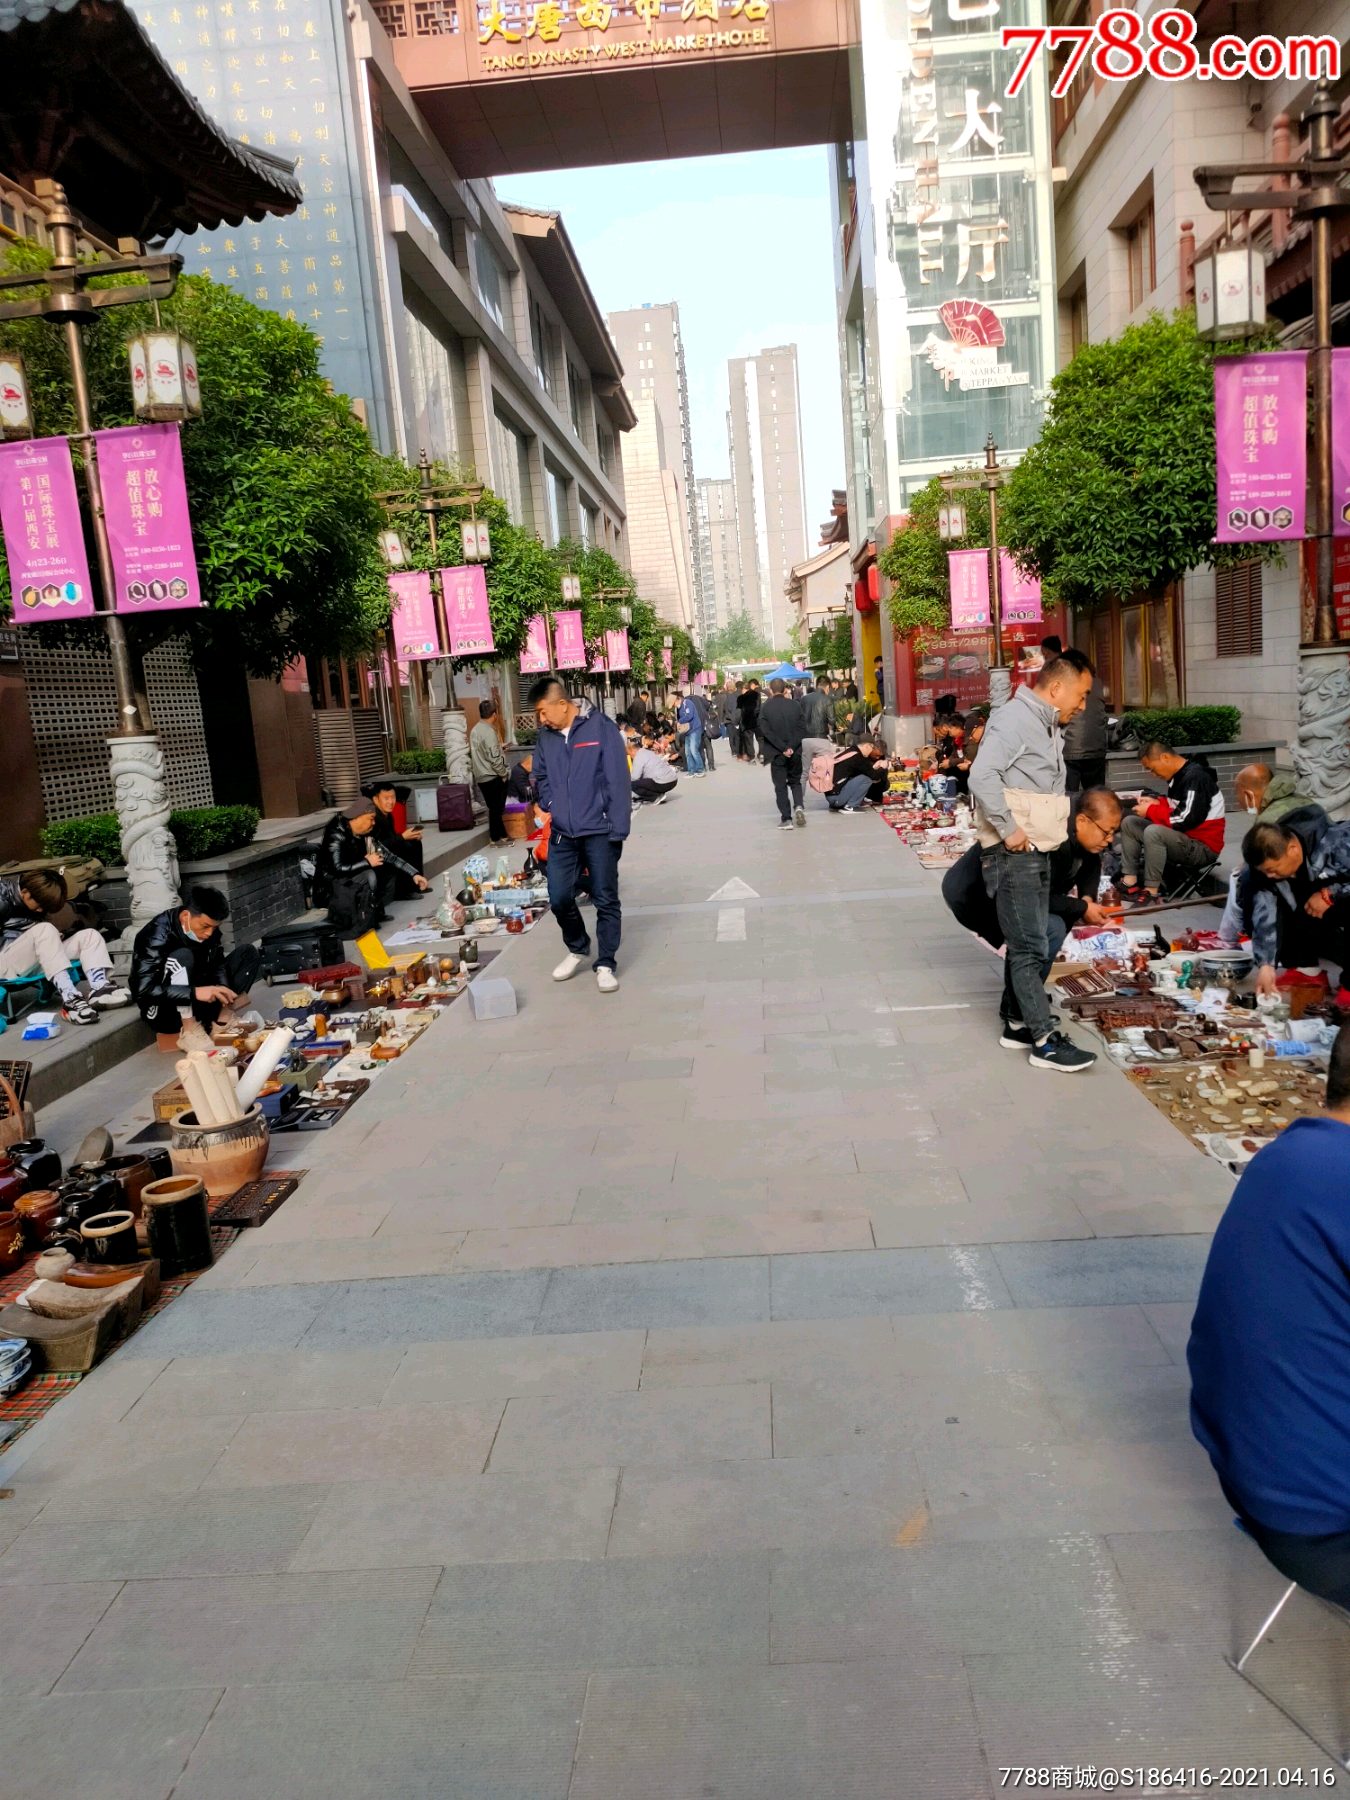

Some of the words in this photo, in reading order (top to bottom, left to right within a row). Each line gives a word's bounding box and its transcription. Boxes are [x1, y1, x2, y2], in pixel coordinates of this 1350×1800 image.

[483, 53, 526, 71] TANG
[528, 44, 601, 67] DYNASTY
[604, 41, 646, 58] WEST
[650, 33, 715, 53] MARKET
[715, 28, 769, 47] HOTEL
[969, 365, 1009, 376] MARKET
[1242, 395, 1260, 464] 超值珠宝
[1261, 393, 1279, 446] 放心购
[20, 477, 41, 550] 第17届西安
[36, 474, 60, 549] 国际珠宝展
[125, 470, 149, 537] 超值珠宝
[143, 468, 163, 519] 放心购
